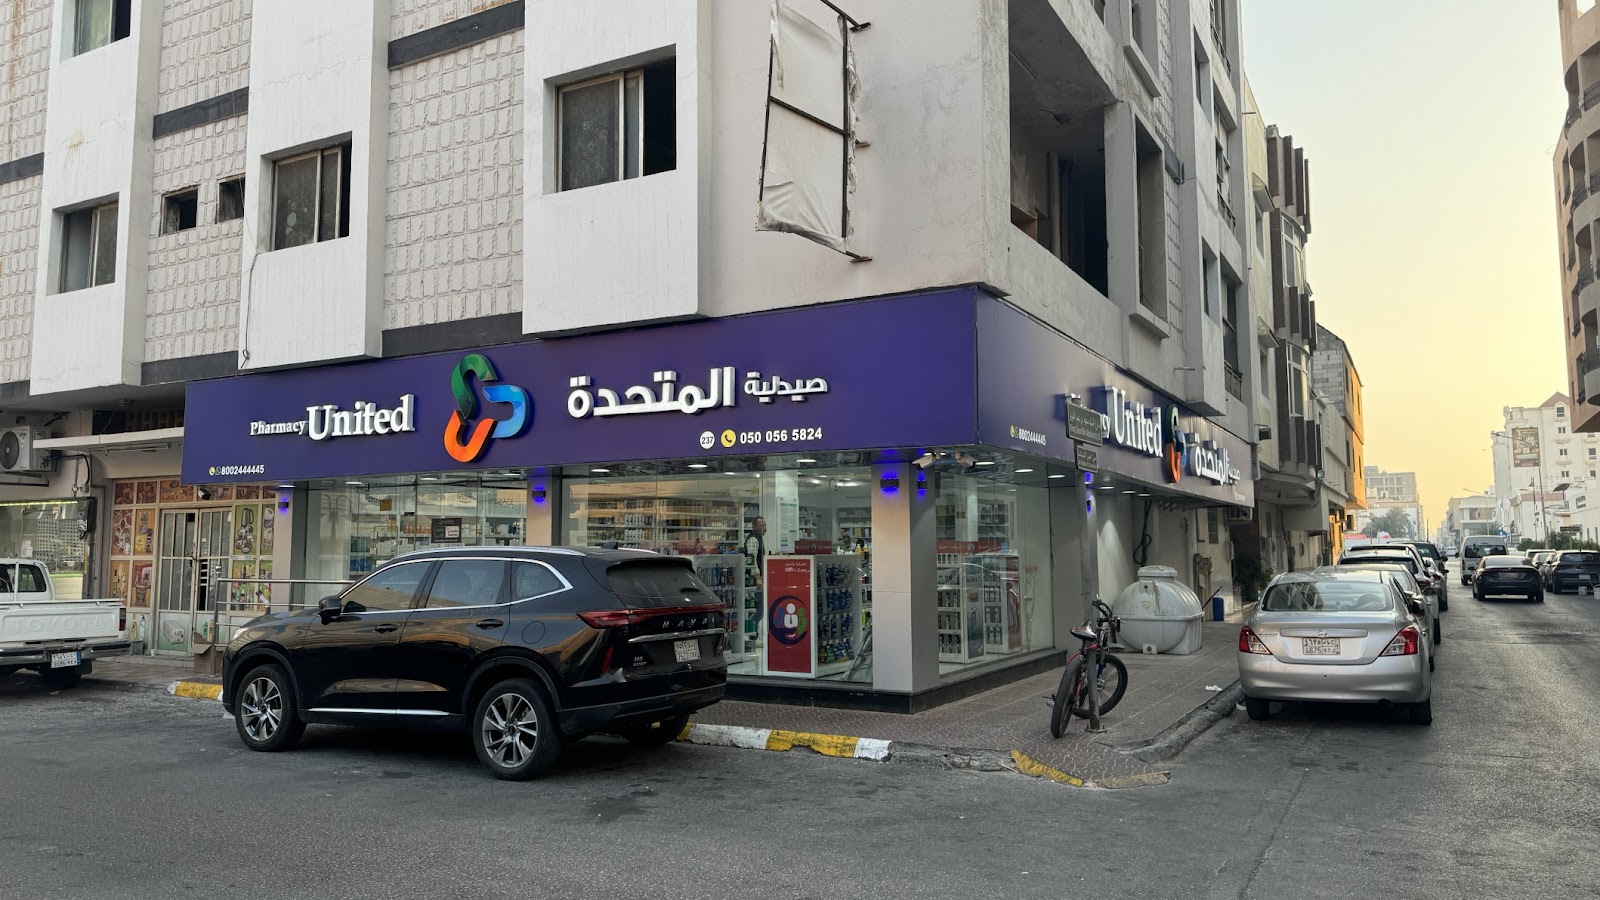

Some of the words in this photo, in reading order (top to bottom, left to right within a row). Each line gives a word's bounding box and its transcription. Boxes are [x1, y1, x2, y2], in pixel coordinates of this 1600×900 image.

[568, 366, 735, 418] المتحدة
[744, 372, 828, 402] صيدلية
[250, 418, 305, 436] Pharmacy
[307, 393, 416, 441] United
[1105, 385, 1164, 458] United
[701, 436, 713, 445] 237
[740, 431, 762, 444] 050
[765, 429, 788, 443] 056
[792, 427, 823, 441] 5824
[221, 464, 265, 476] 8002444445
[13, 616, 105, 633] TOYOTA
[1305, 646, 1322, 654] 4675
